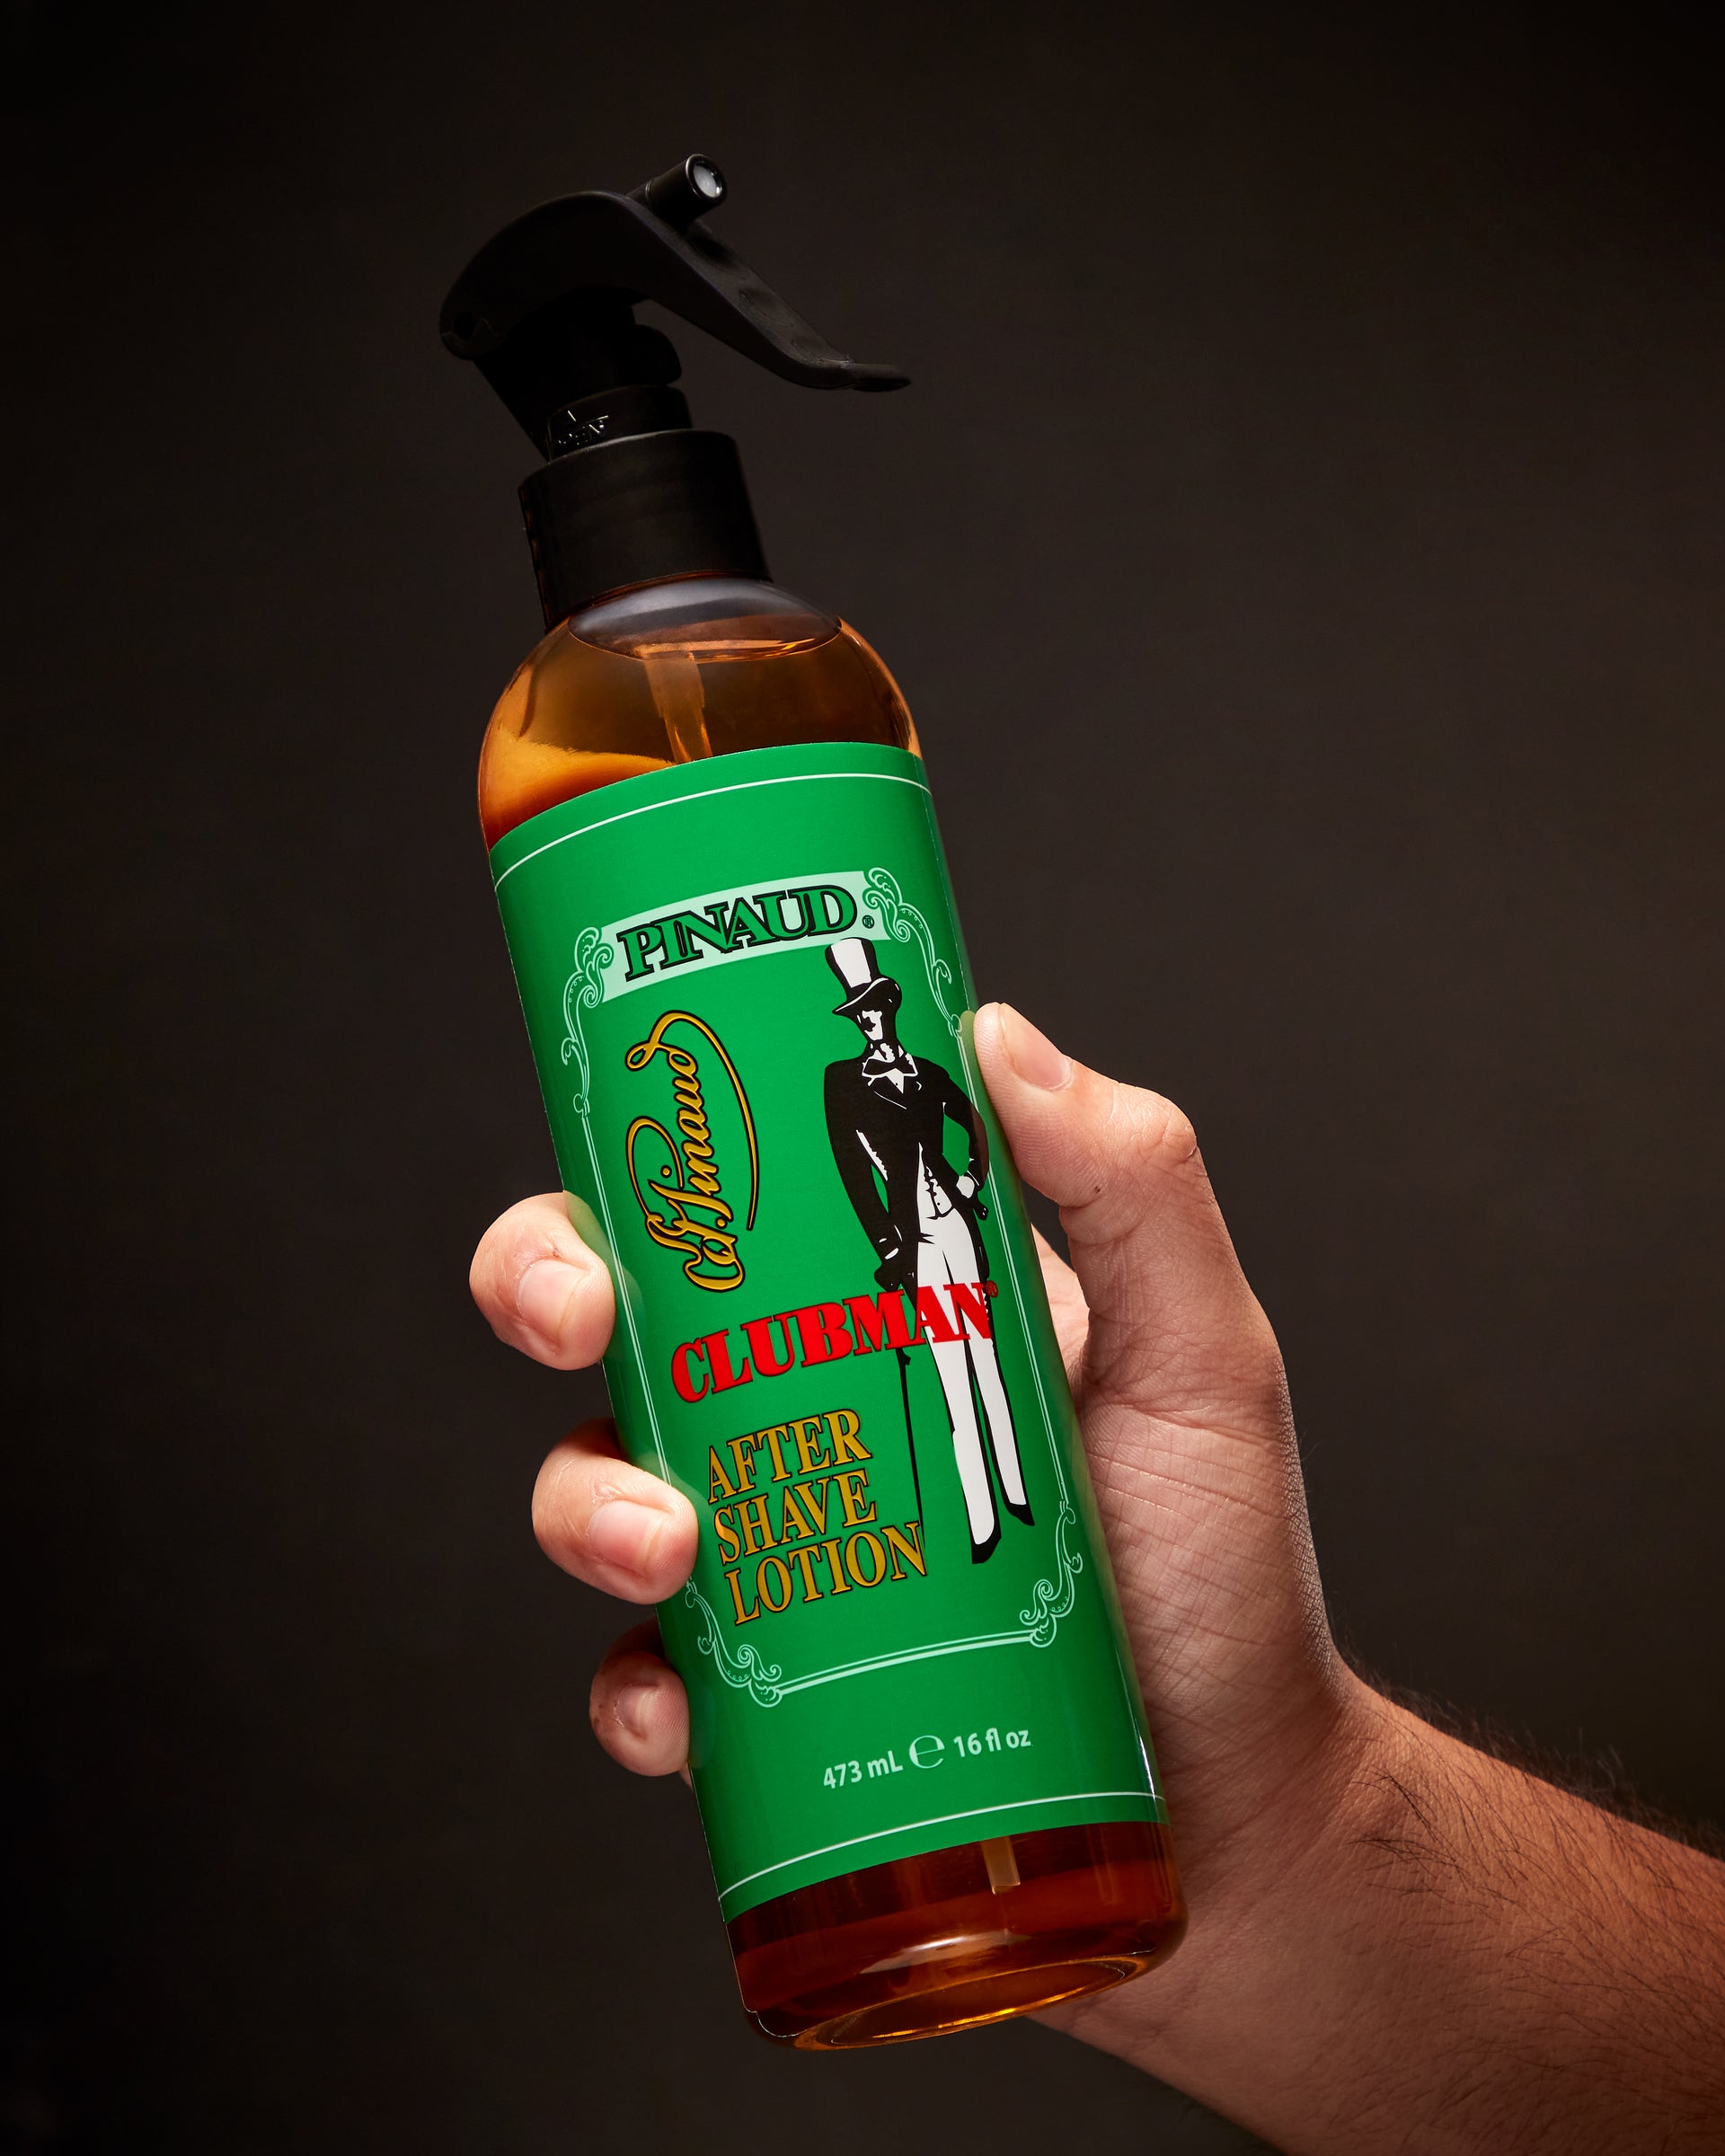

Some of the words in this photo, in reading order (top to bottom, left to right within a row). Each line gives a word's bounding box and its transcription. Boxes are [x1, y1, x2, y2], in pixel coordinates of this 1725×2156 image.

[616, 884, 858, 982] PINAUD
[671, 1282, 993, 1403] CLUBMAN
[707, 1408, 873, 1505] AFTER
[713, 1468, 878, 1567] SHAVE
[724, 1522, 928, 1627] LOTION
[823, 1760, 862, 1789] 473
[867, 1750, 904, 1779] mL
[953, 1733, 982, 1757] 16
[986, 1727, 1002, 1752] fl
[1005, 1729, 1032, 1750] oz
